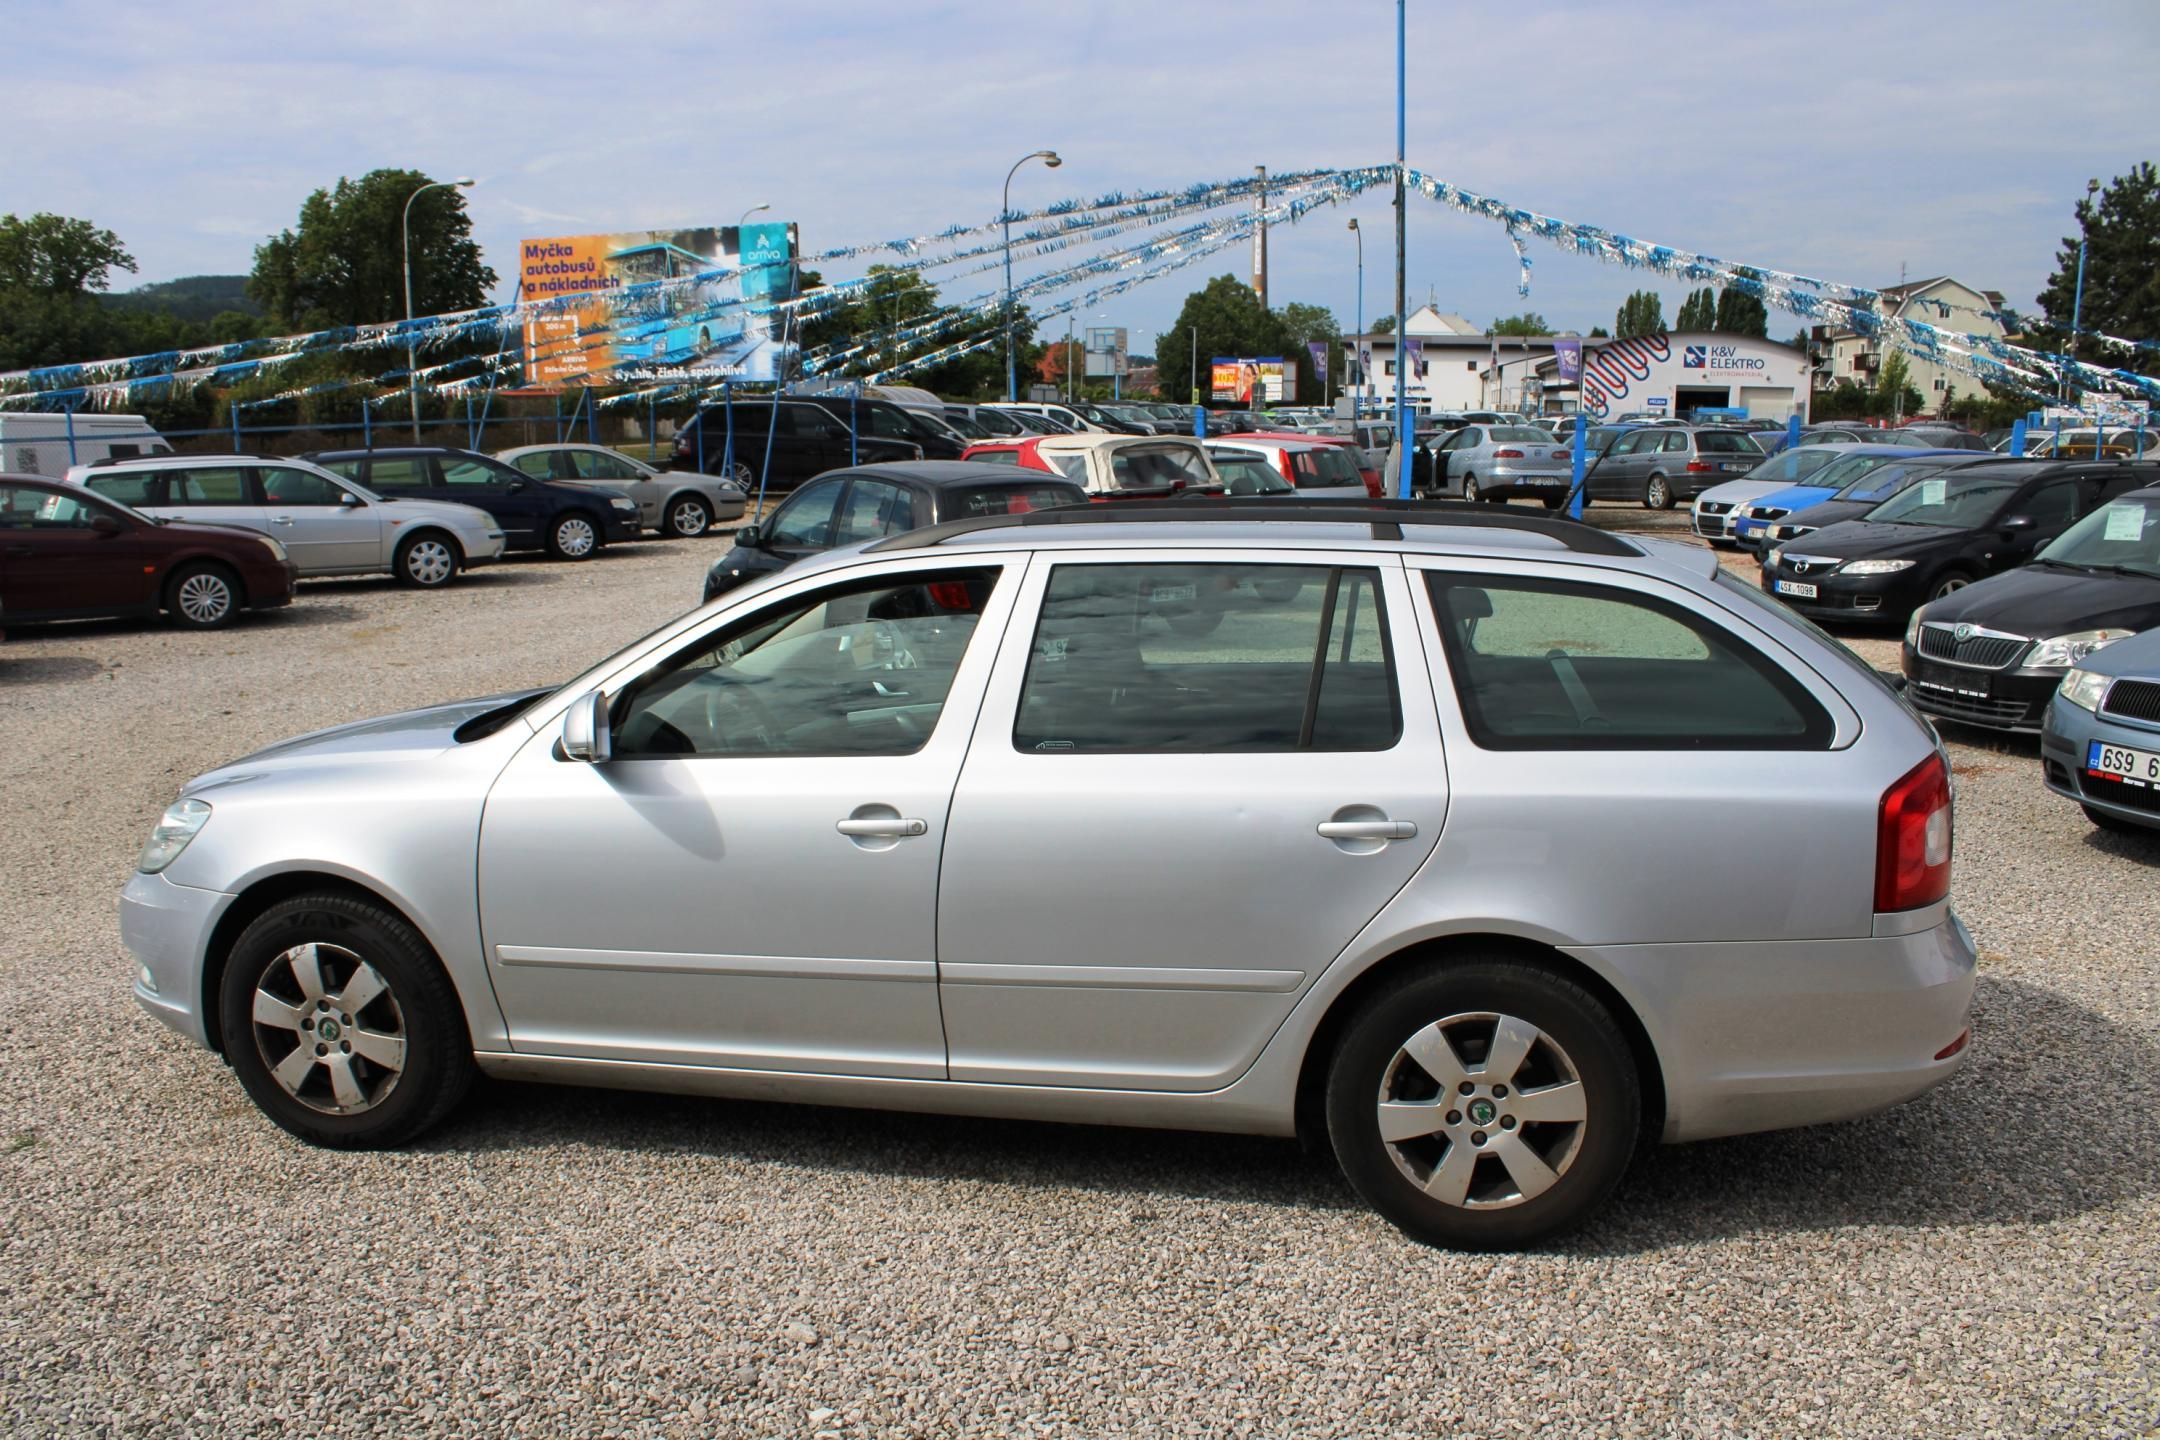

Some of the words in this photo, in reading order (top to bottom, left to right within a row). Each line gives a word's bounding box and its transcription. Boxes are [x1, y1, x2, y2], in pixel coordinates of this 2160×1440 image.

[525, 243, 573, 261] Myčka
[748, 249, 781, 260] arriva
[527, 256, 595, 275] autobusů
[526, 282, 536, 292] a
[539, 275, 620, 292] nákladních
[1711, 346, 1737, 357] K&V
[690, 364, 748, 379] spolehlivě
[1710, 358, 1765, 369] ELEKTRO
[2103, 748, 2135, 773] 6S9
[2148, 757, 2160, 778] 6
